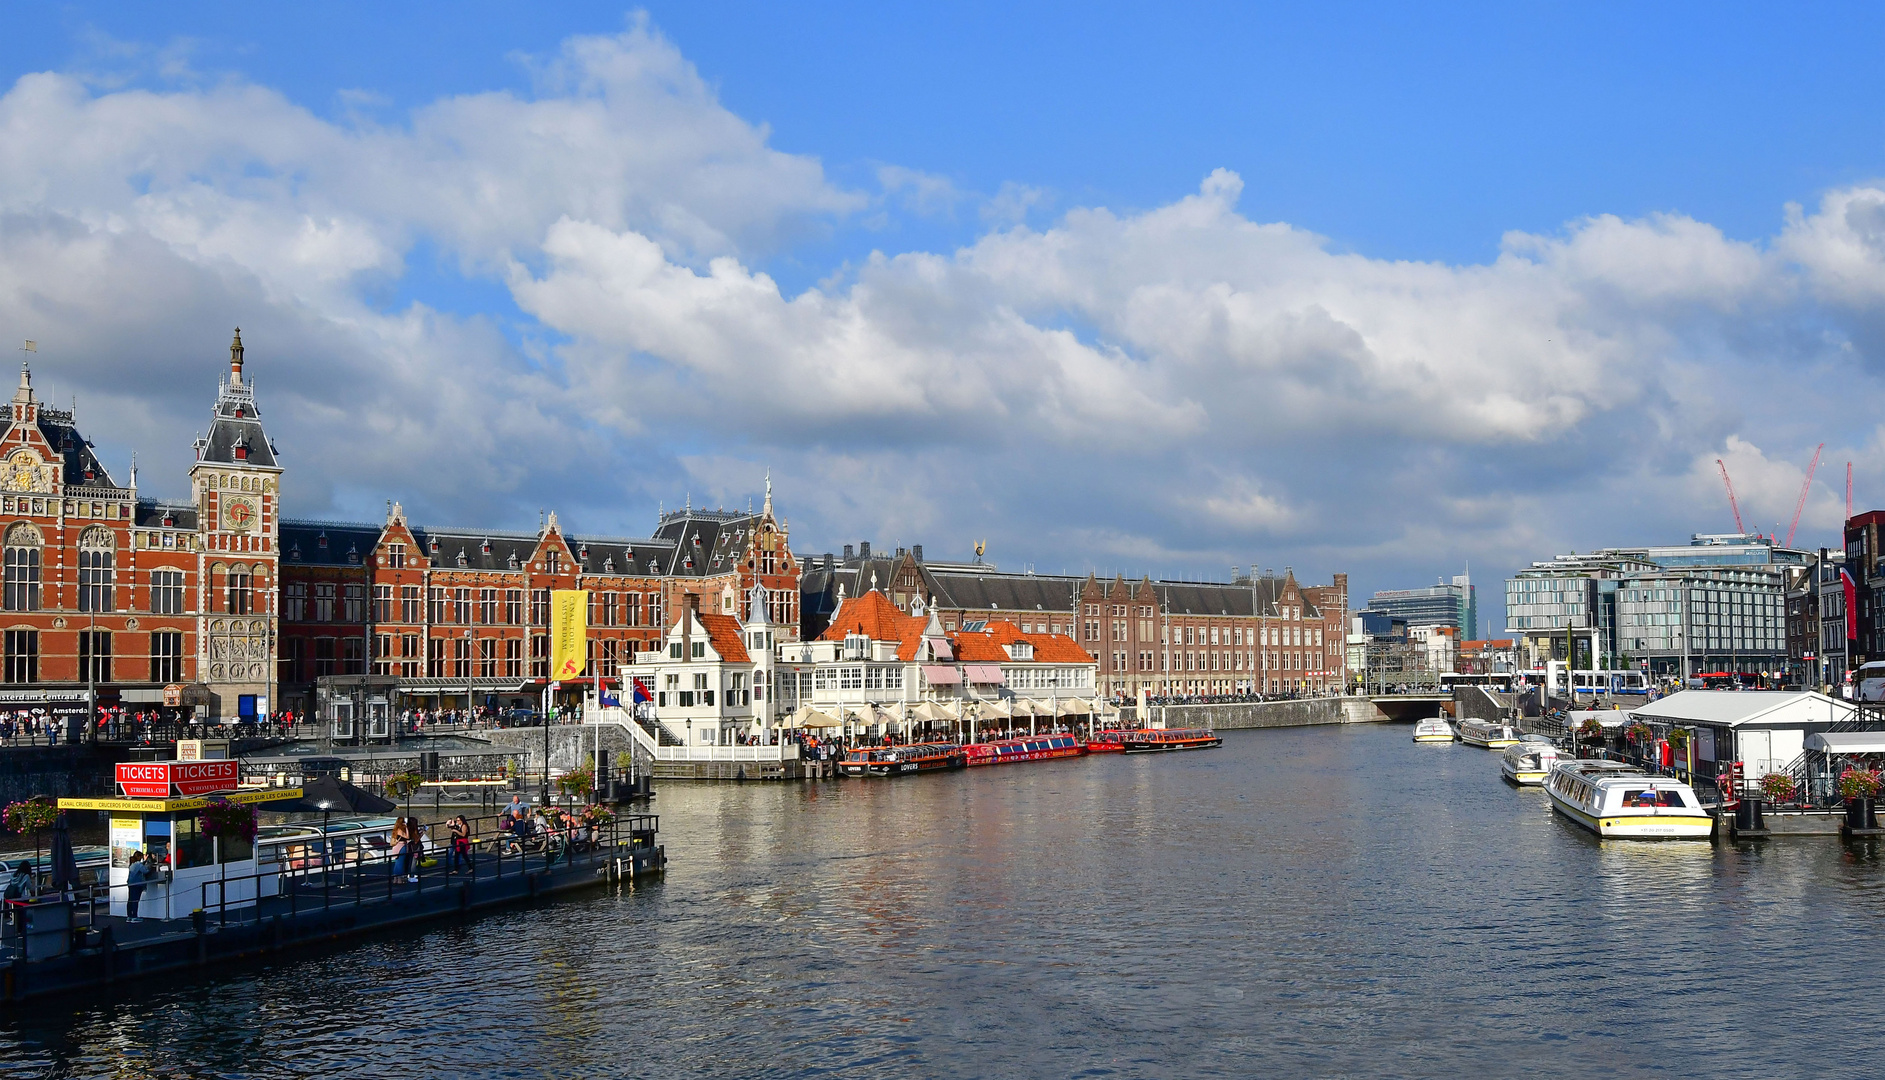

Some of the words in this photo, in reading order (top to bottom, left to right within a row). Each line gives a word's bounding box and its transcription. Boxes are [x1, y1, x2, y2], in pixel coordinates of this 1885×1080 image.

[176, 764, 232, 778] TICKETS
[901, 763, 918, 771] LOVERS
[120, 766, 164, 780] TICKETS
[188, 783, 235, 792] STROMMA.COM
[642, 859, 648, 867] N
